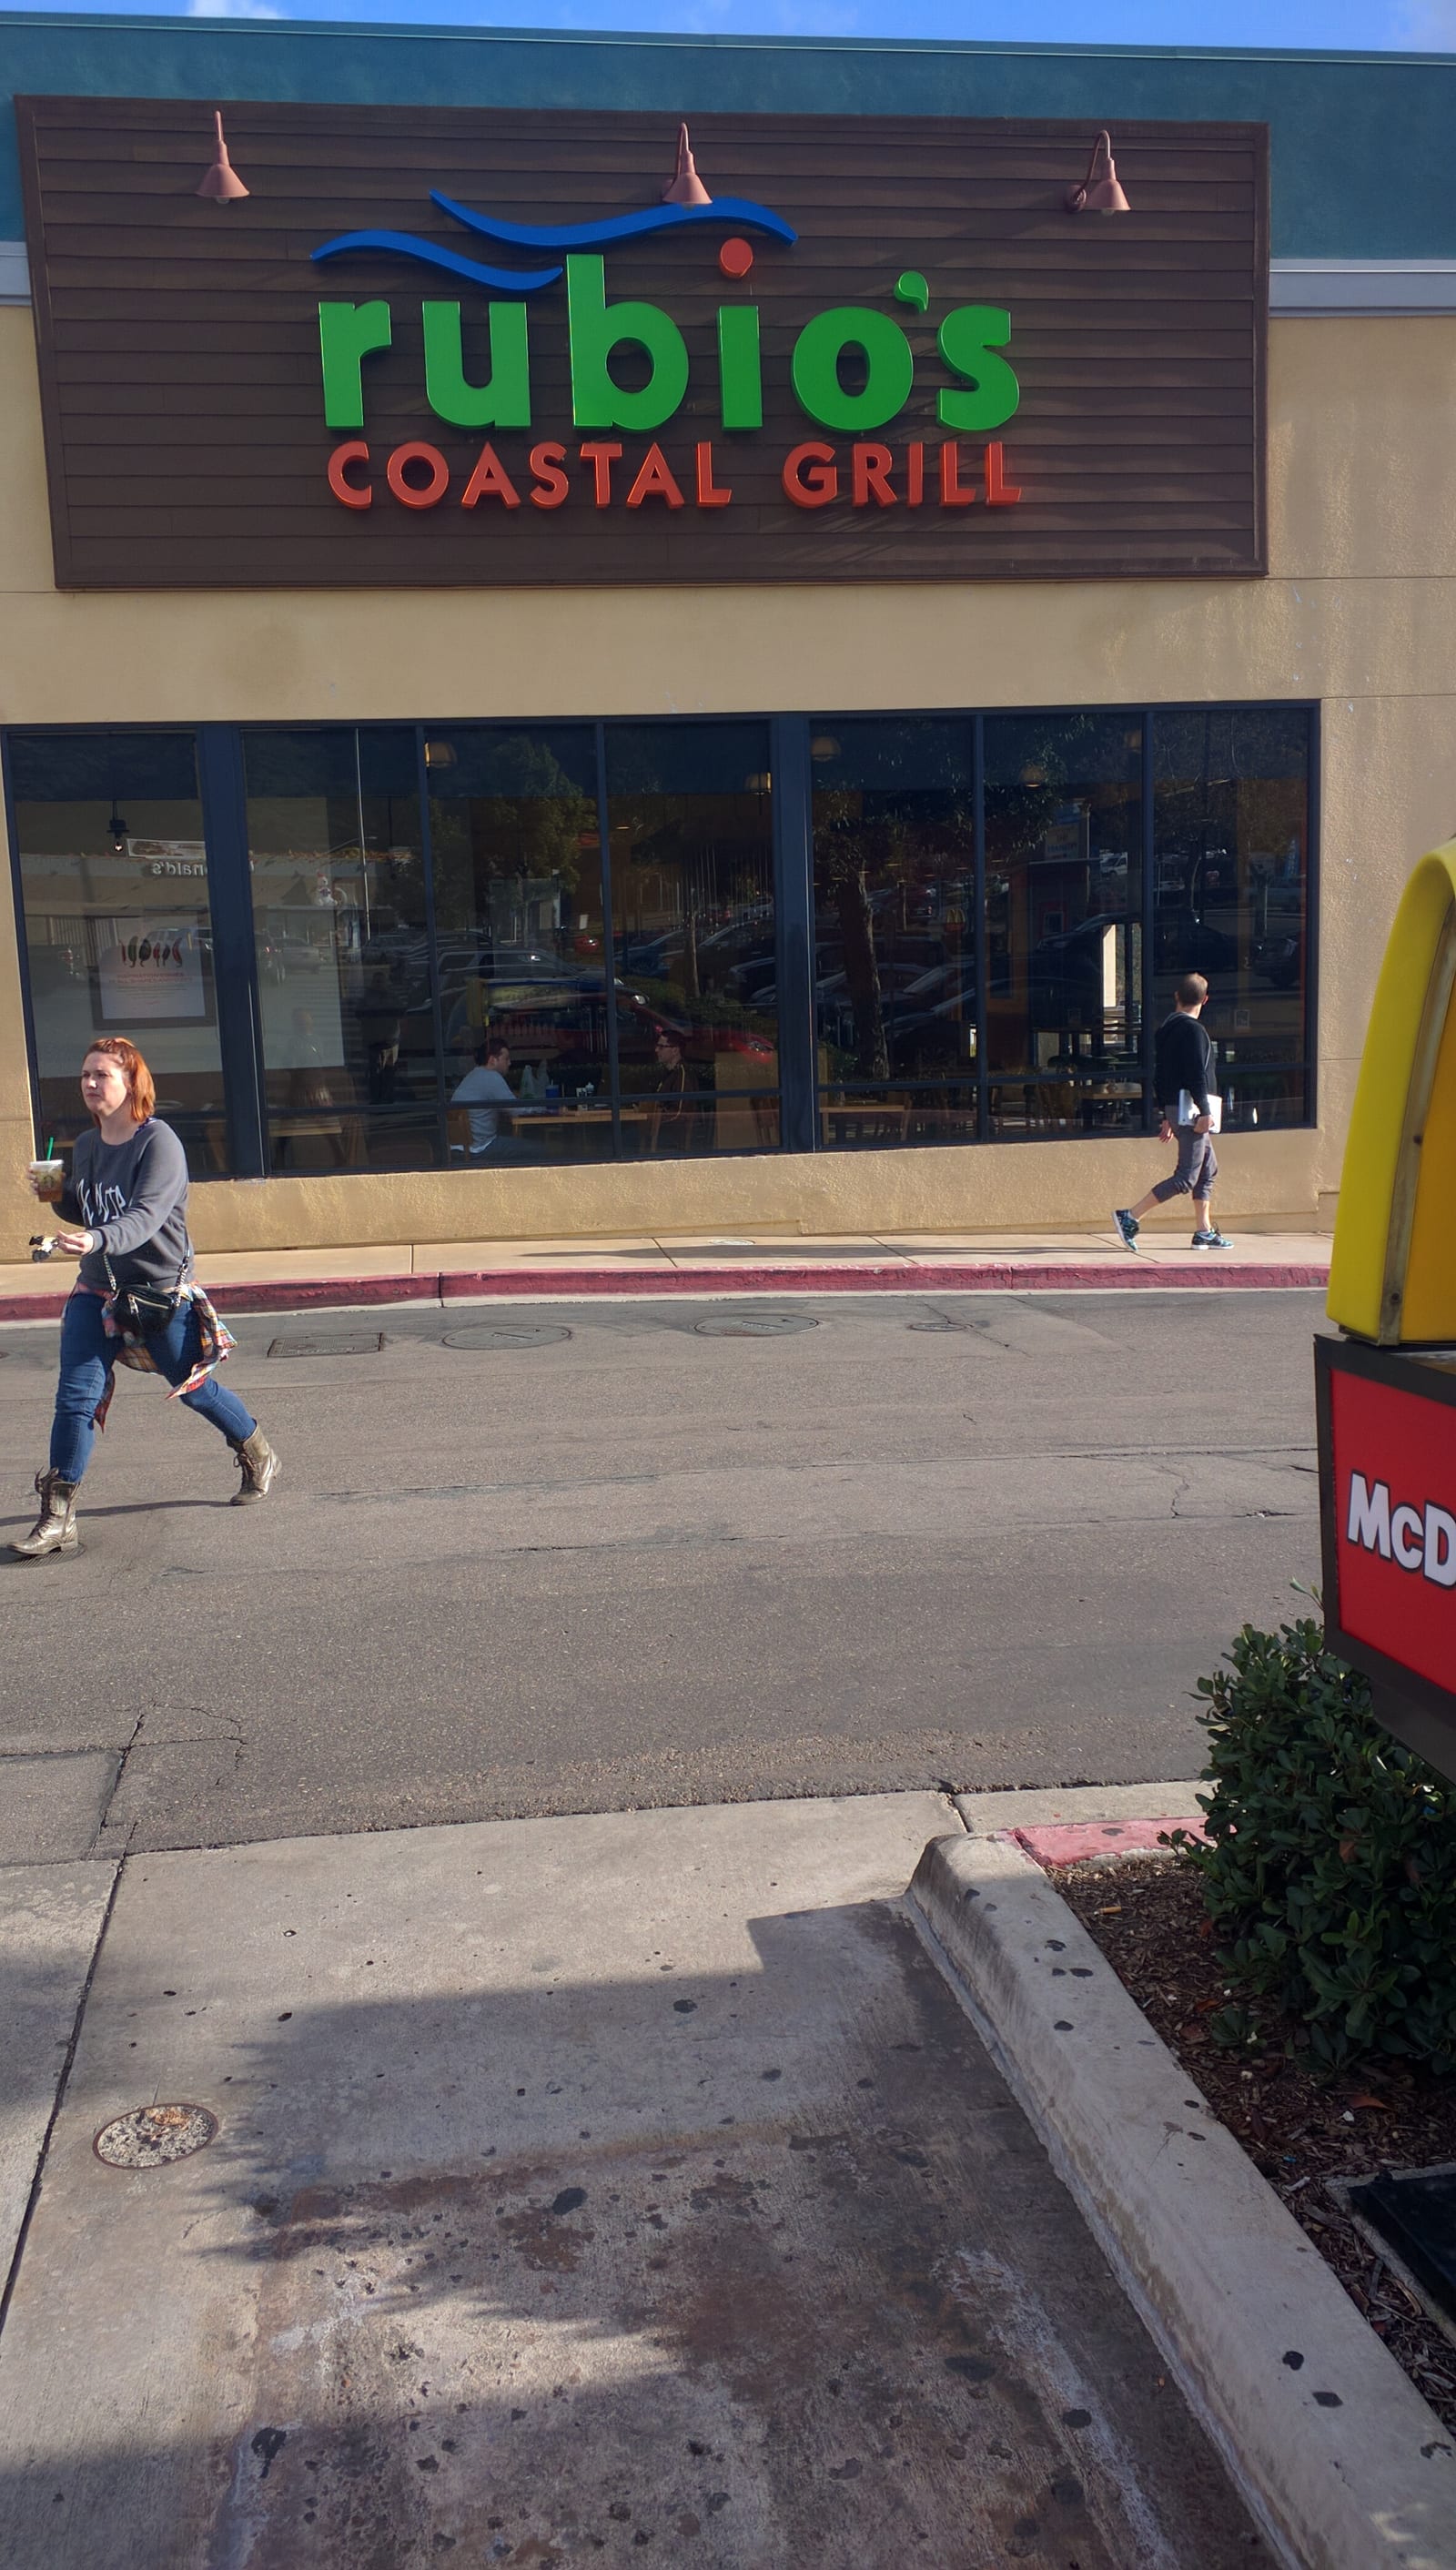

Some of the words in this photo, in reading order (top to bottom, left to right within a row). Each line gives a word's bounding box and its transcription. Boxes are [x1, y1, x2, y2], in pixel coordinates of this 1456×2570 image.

[318, 238, 1021, 431] rubio's
[327, 440, 733, 510] COASTAL
[782, 440, 1022, 509] GRILL
